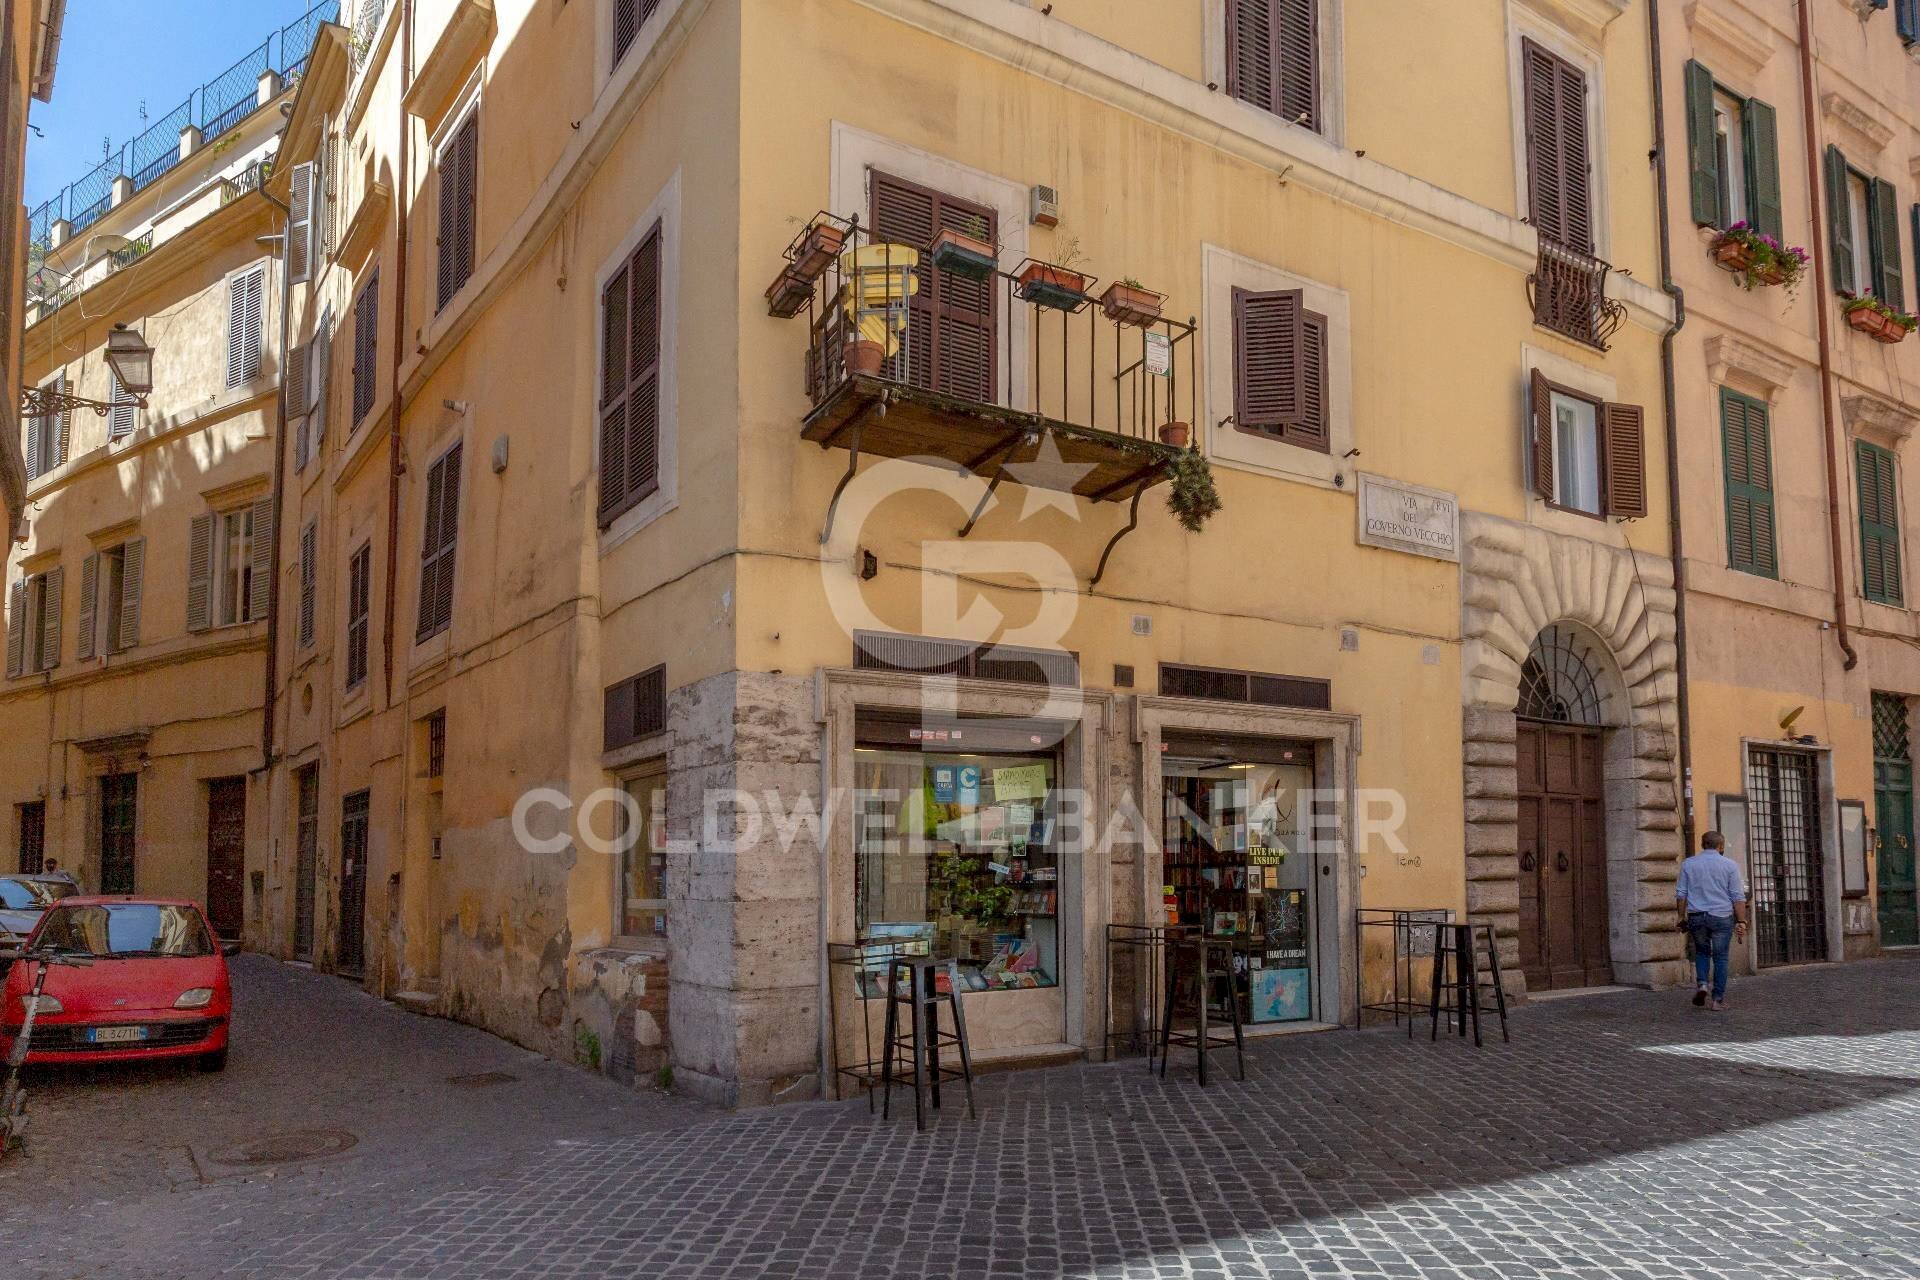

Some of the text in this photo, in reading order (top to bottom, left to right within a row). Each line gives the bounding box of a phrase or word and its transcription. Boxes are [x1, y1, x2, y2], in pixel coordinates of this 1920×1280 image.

[1402, 496, 1418, 510] VIA
[1403, 511, 1417, 523] DEL
[1367, 518, 1453, 546] GOVERNO VECCHIO
[1249, 847, 1284, 856] LIVE PUB
[1253, 856, 1280, 865] INSIDE
[1270, 950, 1283, 959] HAVE
[1288, 949, 1306, 958] DREAM
